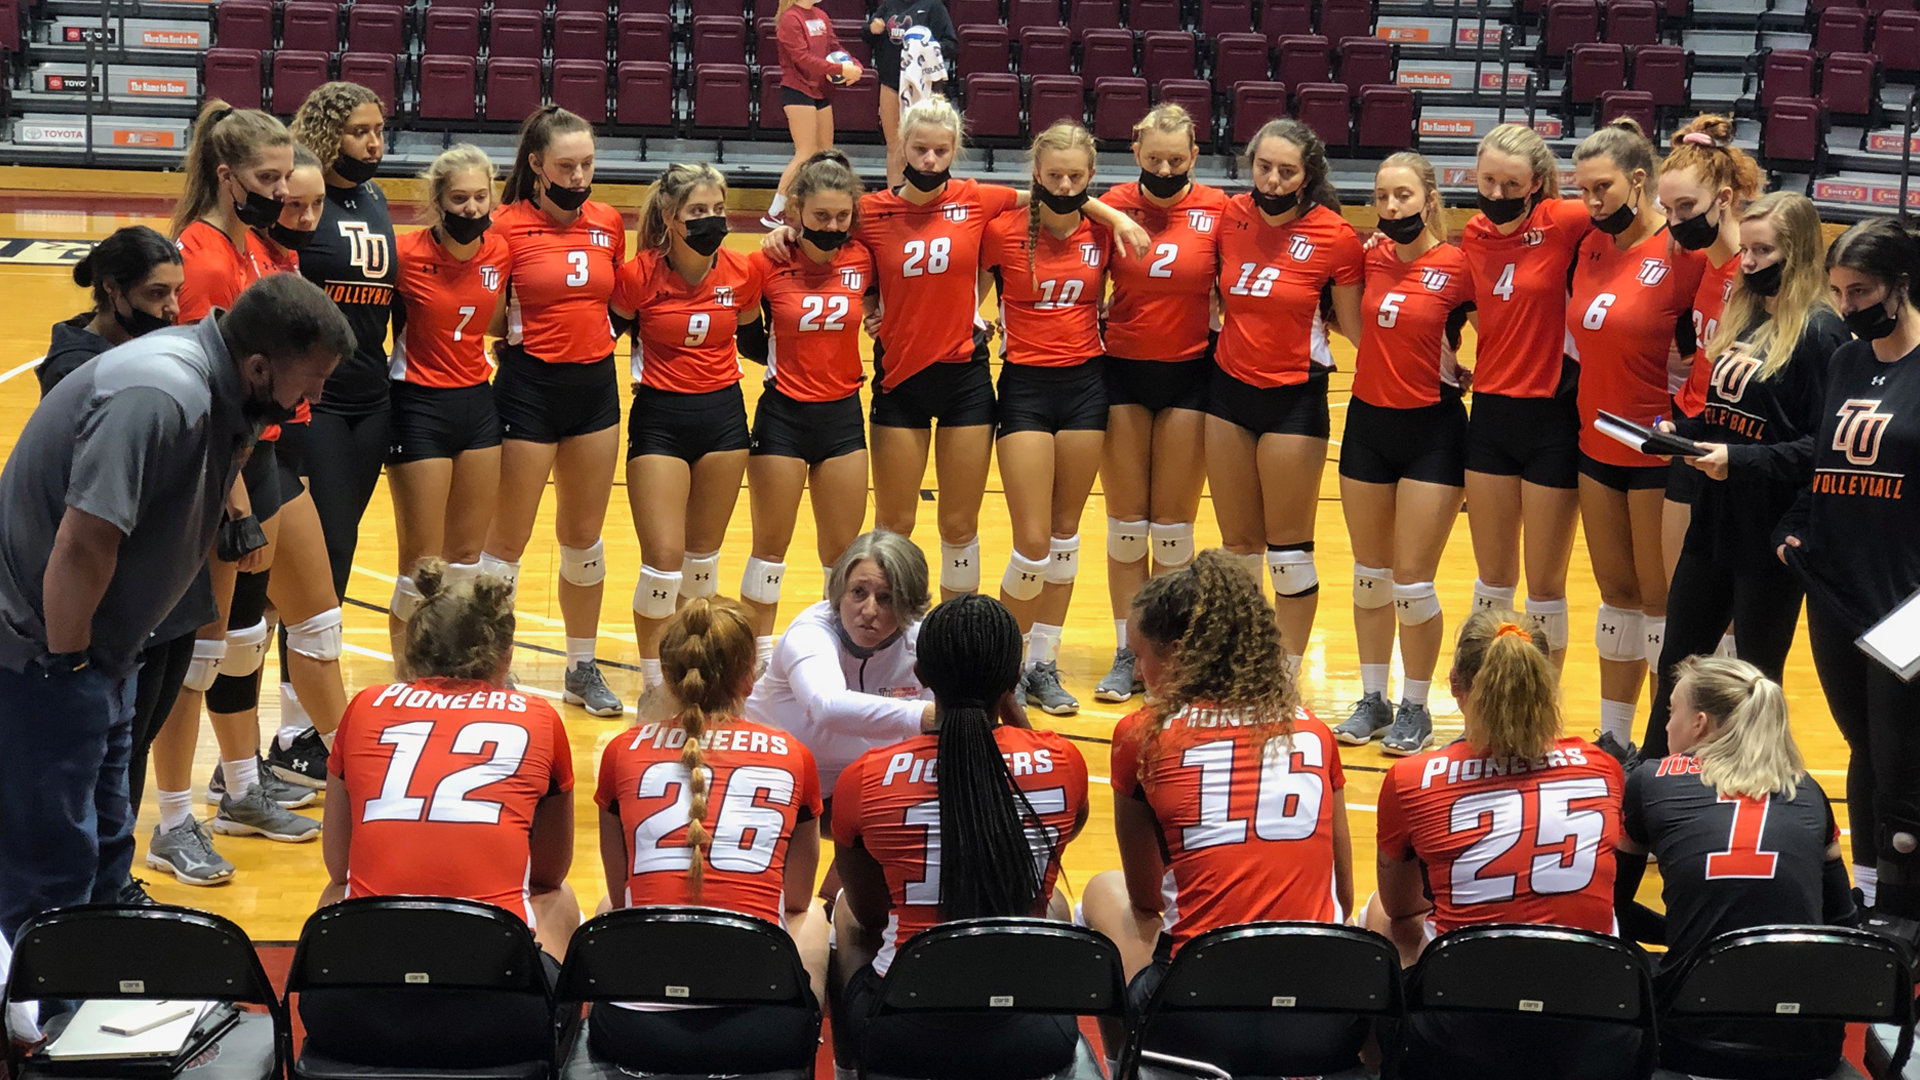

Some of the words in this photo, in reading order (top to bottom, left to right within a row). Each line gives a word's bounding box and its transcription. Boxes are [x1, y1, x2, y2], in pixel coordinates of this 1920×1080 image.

[144, 34, 159, 43] When
[131, 82, 142, 91] The
[143, 82, 160, 92] Name
[160, 84, 167, 92] to
[167, 83, 184, 92] Know
[1400, 75, 1414, 84] When
[44, 130, 83, 138] TOYOTA
[1423, 122, 1432, 131] The
[1433, 123, 1449, 132] Name
[1449, 124, 1456, 132] to
[1456, 123, 1471, 132] Know
[942, 203, 968, 223] TU
[1186, 209, 1214, 234] TU
[337, 221, 389, 278] TU
[588, 228, 611, 248] TU
[1079, 242, 1101, 268] TU
[1288, 234, 1317, 263] TU
[565, 250, 590, 287] 3
[902, 236, 951, 278] 28
[1148, 242, 1179, 278] 2
[1635, 257, 1672, 288] TU
[479, 264, 500, 292] TU
[839, 268, 863, 292] TU
[1034, 279, 1085, 310] 10
[1229, 262, 1281, 297] 18
[1419, 266, 1451, 292] TU
[1492, 262, 1516, 301] 4
[714, 286, 736, 308] TU
[798, 295, 849, 332] 22
[1376, 292, 1407, 328] 5
[1582, 292, 1617, 331] 6
[453, 306, 477, 341] 7
[683, 312, 711, 347] 9
[1710, 341, 1764, 404] TU
[1831, 398, 1894, 466] TU
[372, 682, 528, 713] PIONEERS
[361, 720, 530, 825] 12
[1180, 731, 1325, 850] 16
[632, 761, 796, 875] 26
[1450, 777, 1610, 906] 25
[1705, 791, 1779, 881] 1
